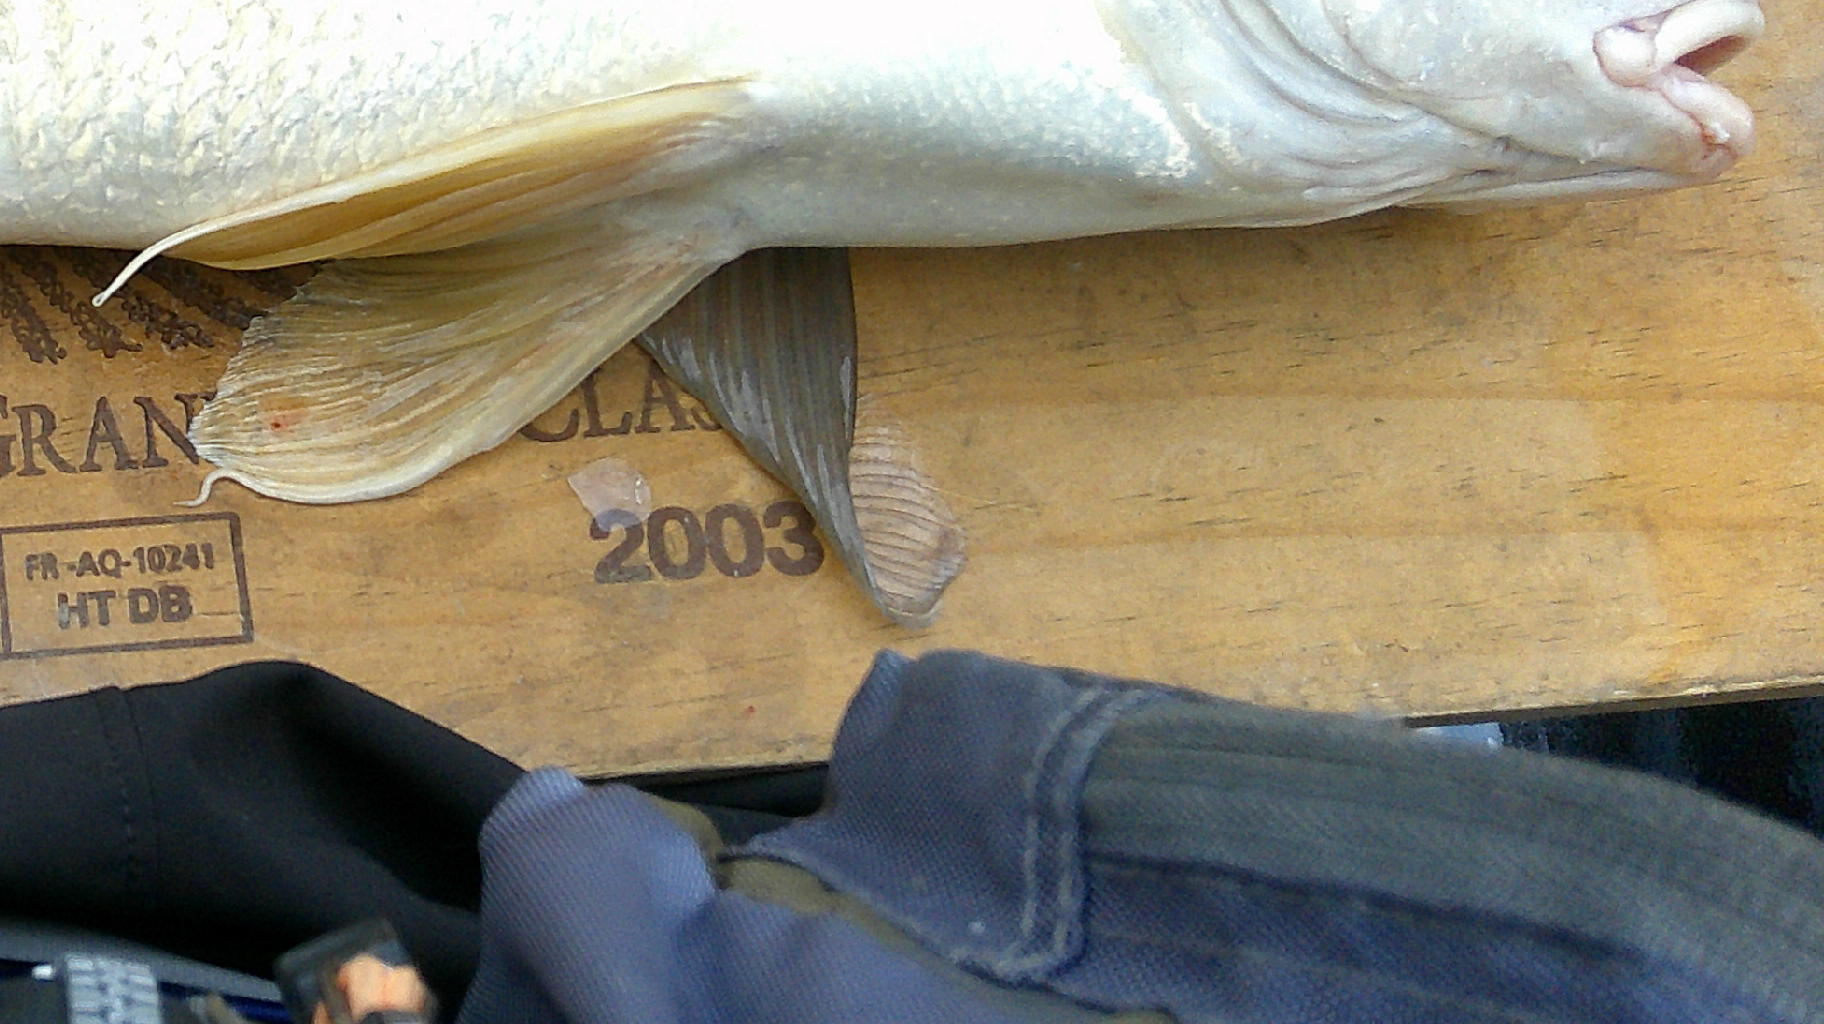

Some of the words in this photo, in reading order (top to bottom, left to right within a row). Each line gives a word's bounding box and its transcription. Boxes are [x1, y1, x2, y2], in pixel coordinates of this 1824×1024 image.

[589, 499, 826, 585] 2003
[57, 589, 117, 630] HT
[127, 584, 194, 625] DB
